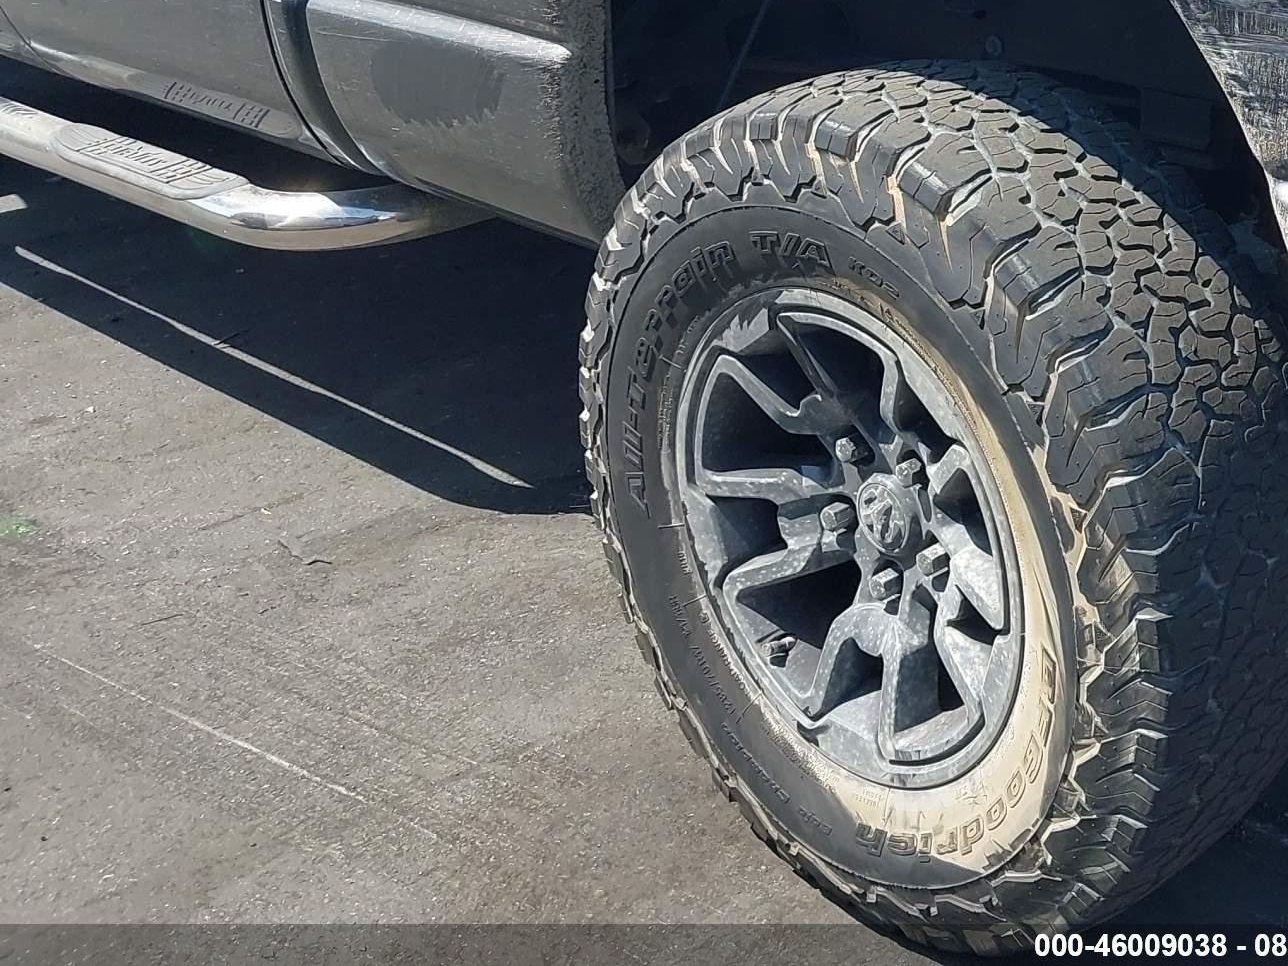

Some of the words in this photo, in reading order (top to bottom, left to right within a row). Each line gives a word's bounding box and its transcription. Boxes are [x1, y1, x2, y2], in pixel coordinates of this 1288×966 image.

[748, 230, 835, 273] T/A
[849, 255, 901, 300] KO2
[854, 647, 1058, 864] BFGoodrich
